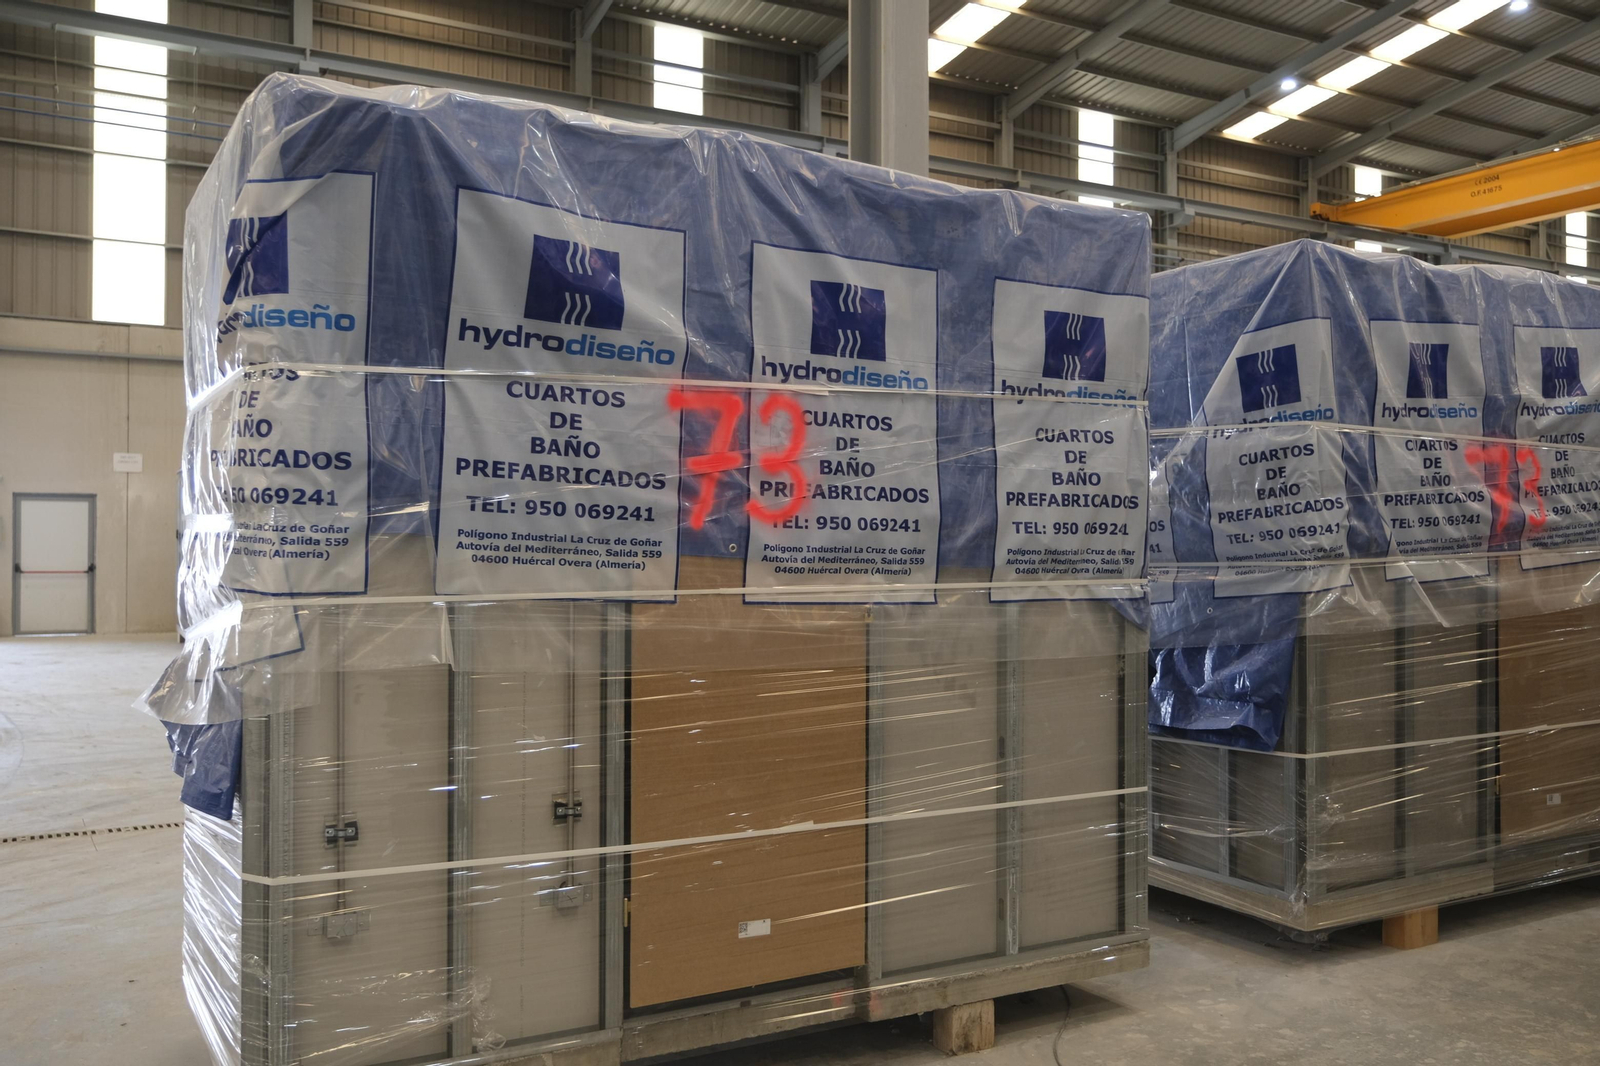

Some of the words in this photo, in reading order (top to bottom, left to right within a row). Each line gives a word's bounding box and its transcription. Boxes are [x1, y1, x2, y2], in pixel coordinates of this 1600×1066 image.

[458, 317, 676, 366] hydrodiseño
[761, 355, 929, 391] hydrodiseño
[239, 390, 260, 408] DE
[506, 380, 626, 408] CUARTOS
[231, 413, 273, 438] AÑO
[549, 411, 583, 431] DE
[801, 409, 893, 432] CUARTOS
[835, 437, 860, 452] DE
[1035, 427, 1114, 445] CUARTOS
[530, 434, 601, 459] BAÑO
[1238, 443, 1315, 466] CUARTOS
[667, 386, 808, 531] 73
[1064, 450, 1087, 465] DE
[1423, 457, 1442, 469] DE
[1555, 450, 1569, 462] DE
[455, 457, 667, 490] PREFABRICADOS
[819, 457, 876, 478] BAÑO
[1052, 467, 1101, 486] BAÑO
[1265, 466, 1287, 481] DE
[1550, 464, 1575, 479] BAÑO
[250, 487, 338, 506] 069241
[1257, 480, 1300, 501] BAÑO
[466, 495, 516, 514] TEL:
[524, 499, 567, 517] 950
[574, 502, 655, 522] 069241
[1005, 491, 1139, 509] PREFABRICADOS
[1217, 497, 1344, 524] PREFABRICADOS
[1552, 506, 1571, 516] 950
[289, 523, 306, 533] de
[310, 523, 350, 534] Goñar
[816, 515, 852, 531] 950
[857, 517, 921, 533] 069241
[1012, 521, 1046, 535] TEL:
[1053, 522, 1079, 535] 950
[1390, 518, 1415, 529] TEL:
[1418, 516, 1440, 528] 950
[280, 536, 321, 546] Salida
[325, 537, 349, 547] 559
[457, 528, 508, 543] Polígono
[511, 531, 567, 544] Industrial
[570, 533, 584, 544] La
[587, 535, 611, 546] Cruz
[613, 536, 628, 546] de
[630, 536, 663, 548] Goñar
[1226, 533, 1254, 545] TEL:
[1259, 529, 1284, 542] 950
[268, 548, 330, 561] (Almería)
[455, 540, 500, 552] Autovía
[503, 542, 522, 553] del
[524, 543, 603, 558] Mediterráneo,
[605, 548, 639, 559] Salida
[641, 549, 662, 559] 559
[763, 543, 804, 556] Polígono
[806, 545, 852, 554] Industrial
[854, 546, 864, 554] La
[866, 546, 886, 555] Cruz
[888, 546, 898, 555] de
[900, 546, 926, 555] Goñar
[1007, 547, 1042, 558] Polígono
[1044, 548, 1079, 556] Industrial
[1086, 548, 1105, 556] Cruz
[1106, 548, 1116, 556] de
[1255, 550, 1288, 560] Industrial
[471, 554, 509, 565] 04600
[512, 554, 555, 567] Huércal
[558, 557, 592, 568] Overa
[595, 559, 646, 571] (Almería)
[761, 554, 798, 564] Autovía
[801, 555, 816, 564] del
[817, 556, 879, 566] Mediterráneo,
[881, 556, 907, 566] Salida
[909, 557, 925, 566] 559
[1006, 557, 1036, 566] Autovía
[774, 566, 805, 575] 04600
[807, 566, 841, 575] Huércal
[844, 566, 869, 575] Overa
[871, 567, 912, 576] (Almería)
[1015, 567, 1039, 575] 04600
[1041, 566, 1069, 575] Huércal
